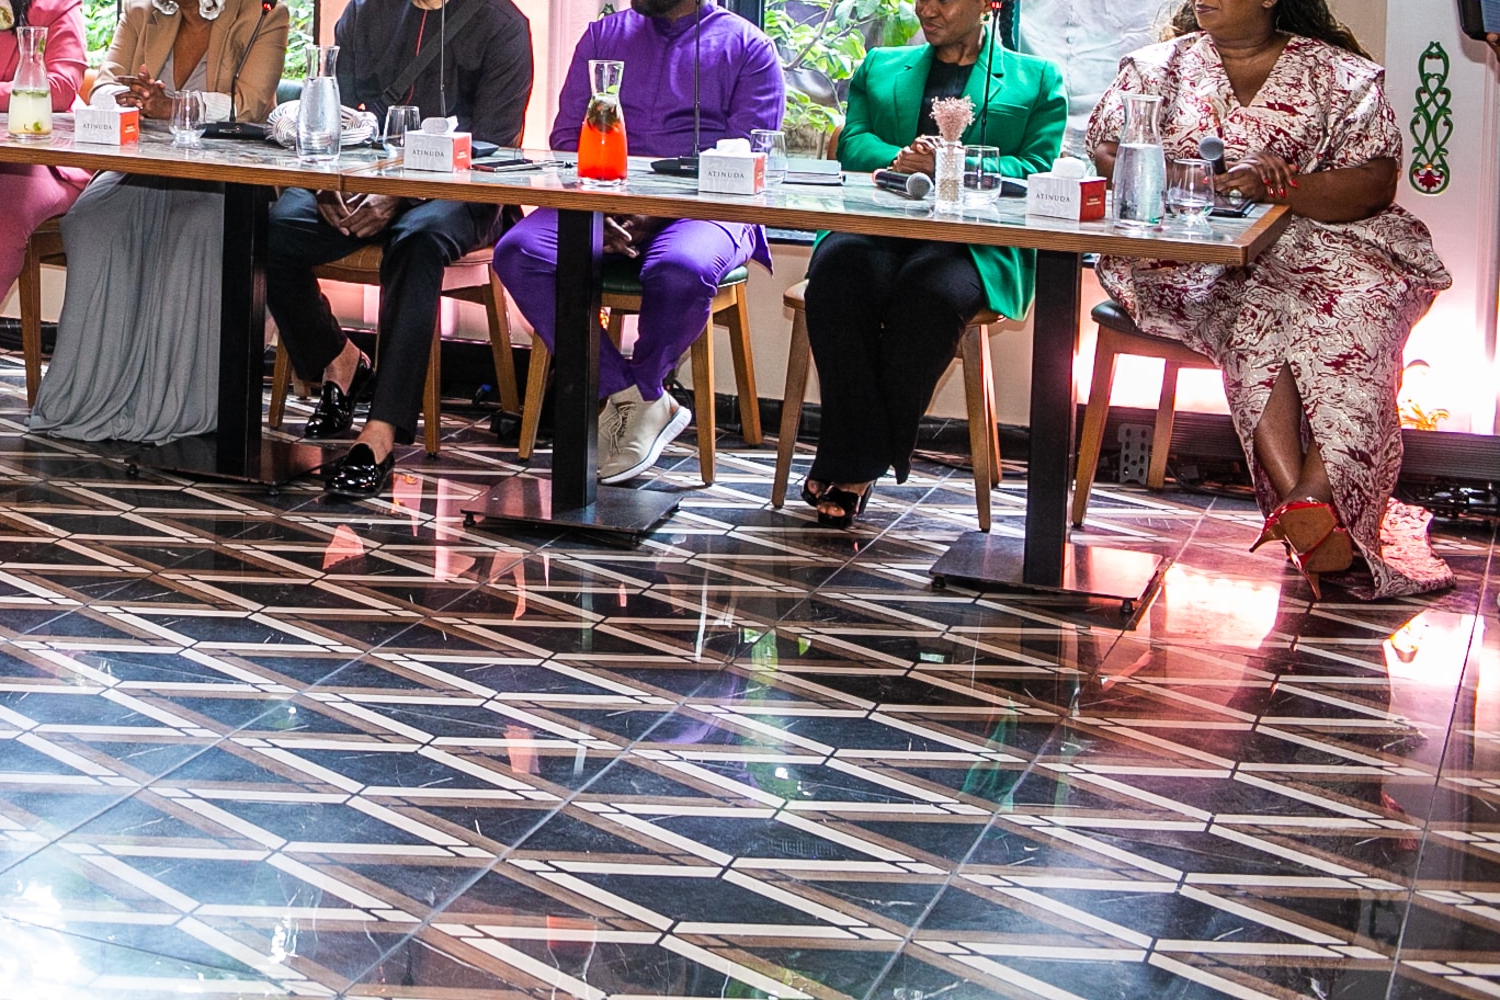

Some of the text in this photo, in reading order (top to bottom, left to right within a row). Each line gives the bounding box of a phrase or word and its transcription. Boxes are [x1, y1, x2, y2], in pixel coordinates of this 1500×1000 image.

[412, 149, 445, 158] ATINUDA
[707, 170, 745, 179] ATINUDA
[1036, 193, 1071, 203] ATINUDA
